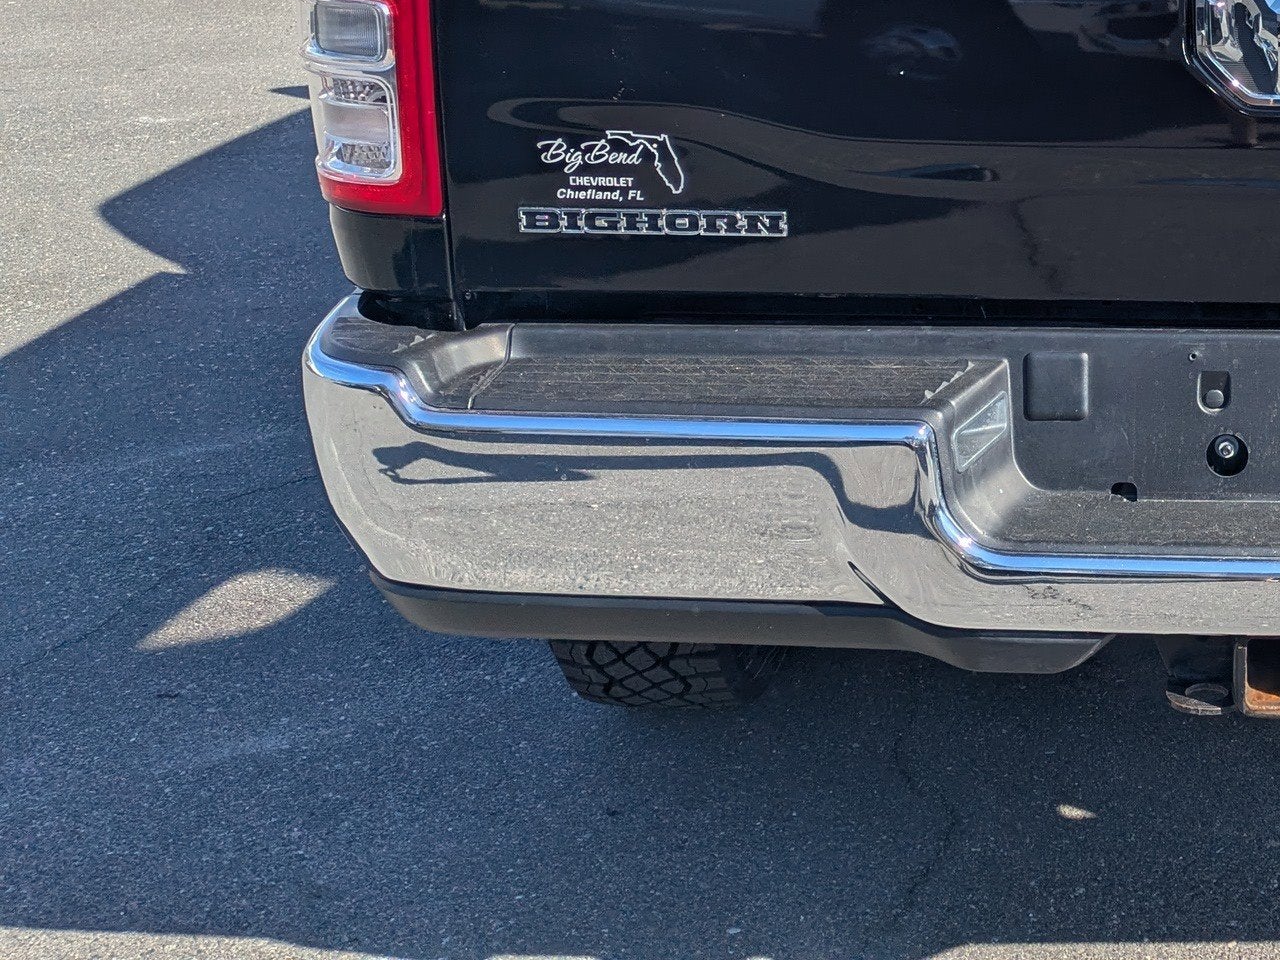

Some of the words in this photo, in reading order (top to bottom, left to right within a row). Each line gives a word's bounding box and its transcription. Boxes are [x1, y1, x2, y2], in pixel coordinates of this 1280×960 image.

[537, 138, 583, 173] Big
[580, 139, 643, 165] Bend
[569, 175, 634, 187] CHEVROLET
[556, 188, 624, 202] Chiefland,
[627, 190, 645, 201] FL
[518, 207, 788, 237] BIGHORN
